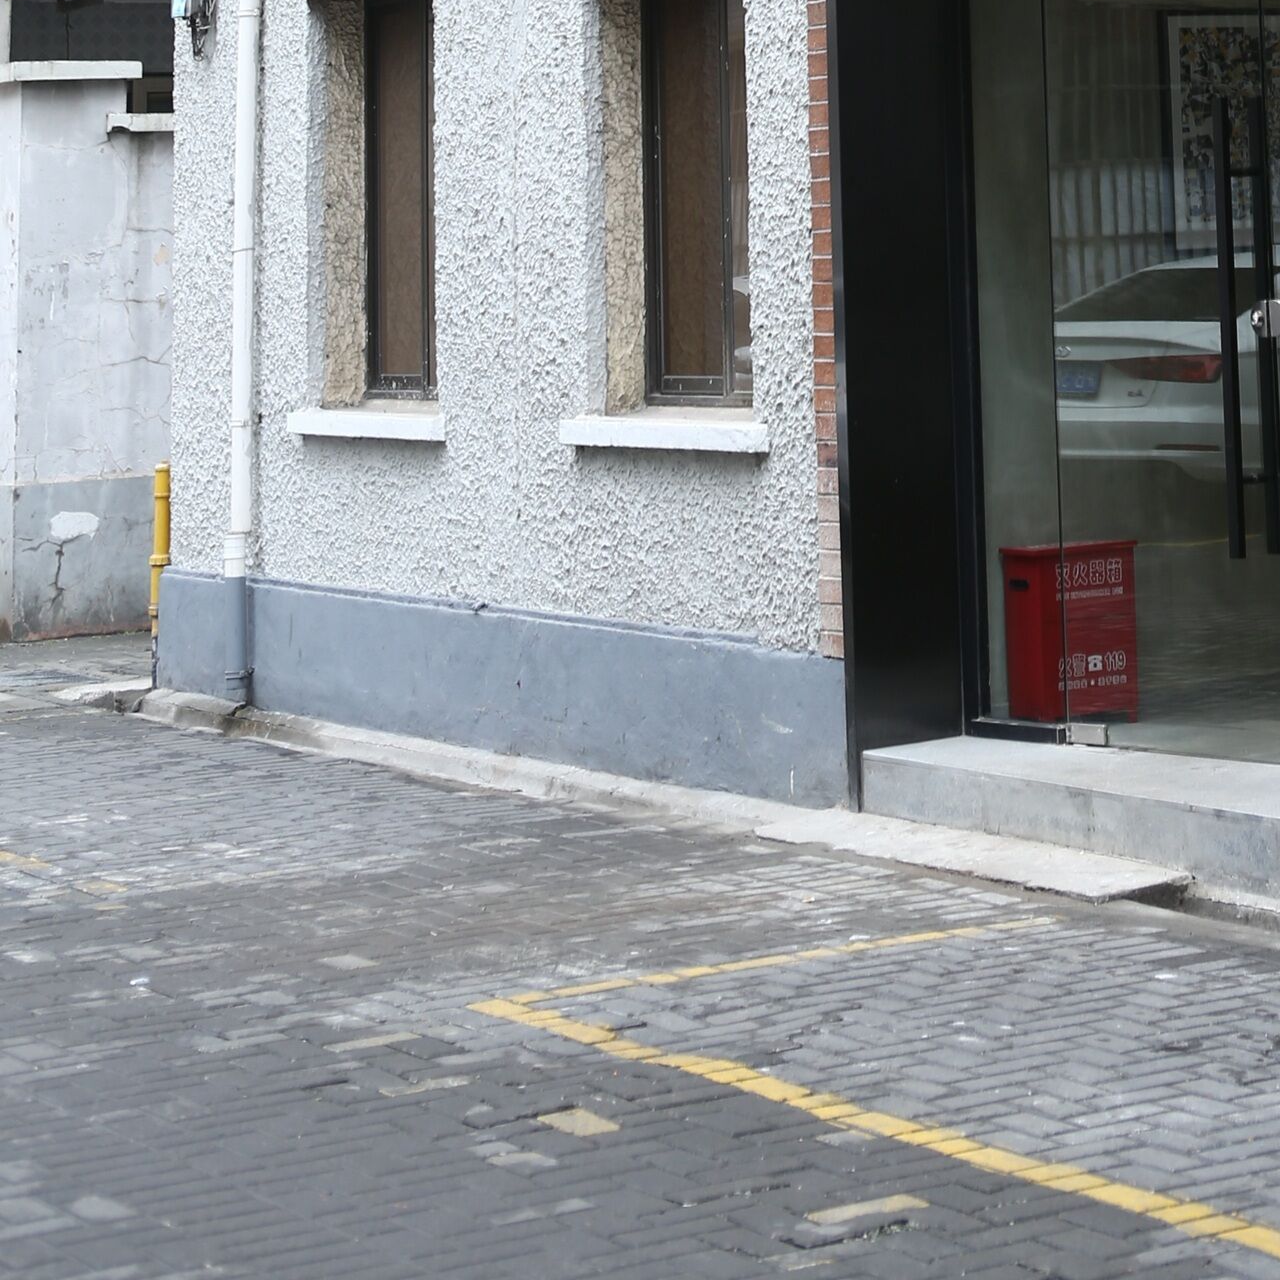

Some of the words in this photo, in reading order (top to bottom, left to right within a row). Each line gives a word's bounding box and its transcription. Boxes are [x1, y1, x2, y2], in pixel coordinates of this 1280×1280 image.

[1055, 558, 1123, 589] 灭火器箱
[1104, 650, 1126, 672] 119
